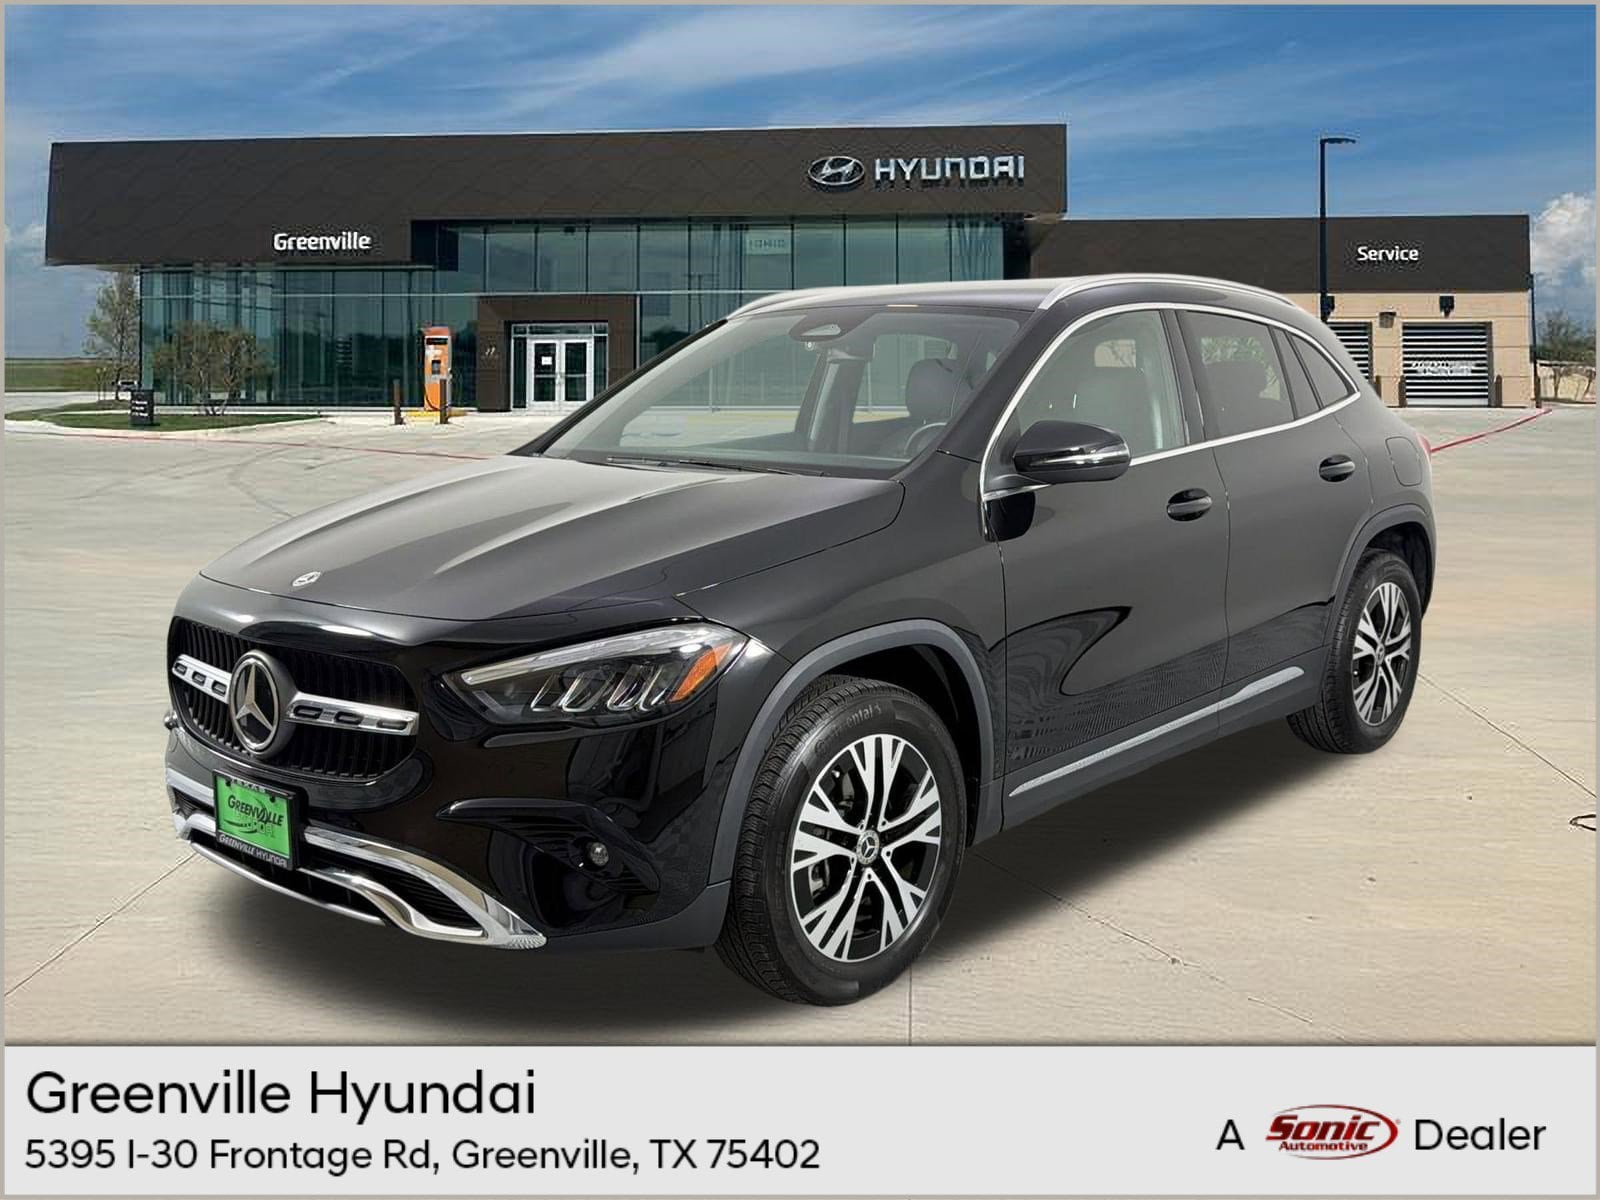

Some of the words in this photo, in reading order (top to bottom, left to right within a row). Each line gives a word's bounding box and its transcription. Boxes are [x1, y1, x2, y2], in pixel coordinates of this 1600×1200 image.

[875, 155, 1025, 181] HYUNDAI
[273, 231, 372, 251] Greenville
[1357, 245, 1419, 261] Service
[229, 795, 284, 826] GREENVILLE
[219, 834, 255, 855] GREENVILLE
[257, 849, 288, 868] HYUNDAI
